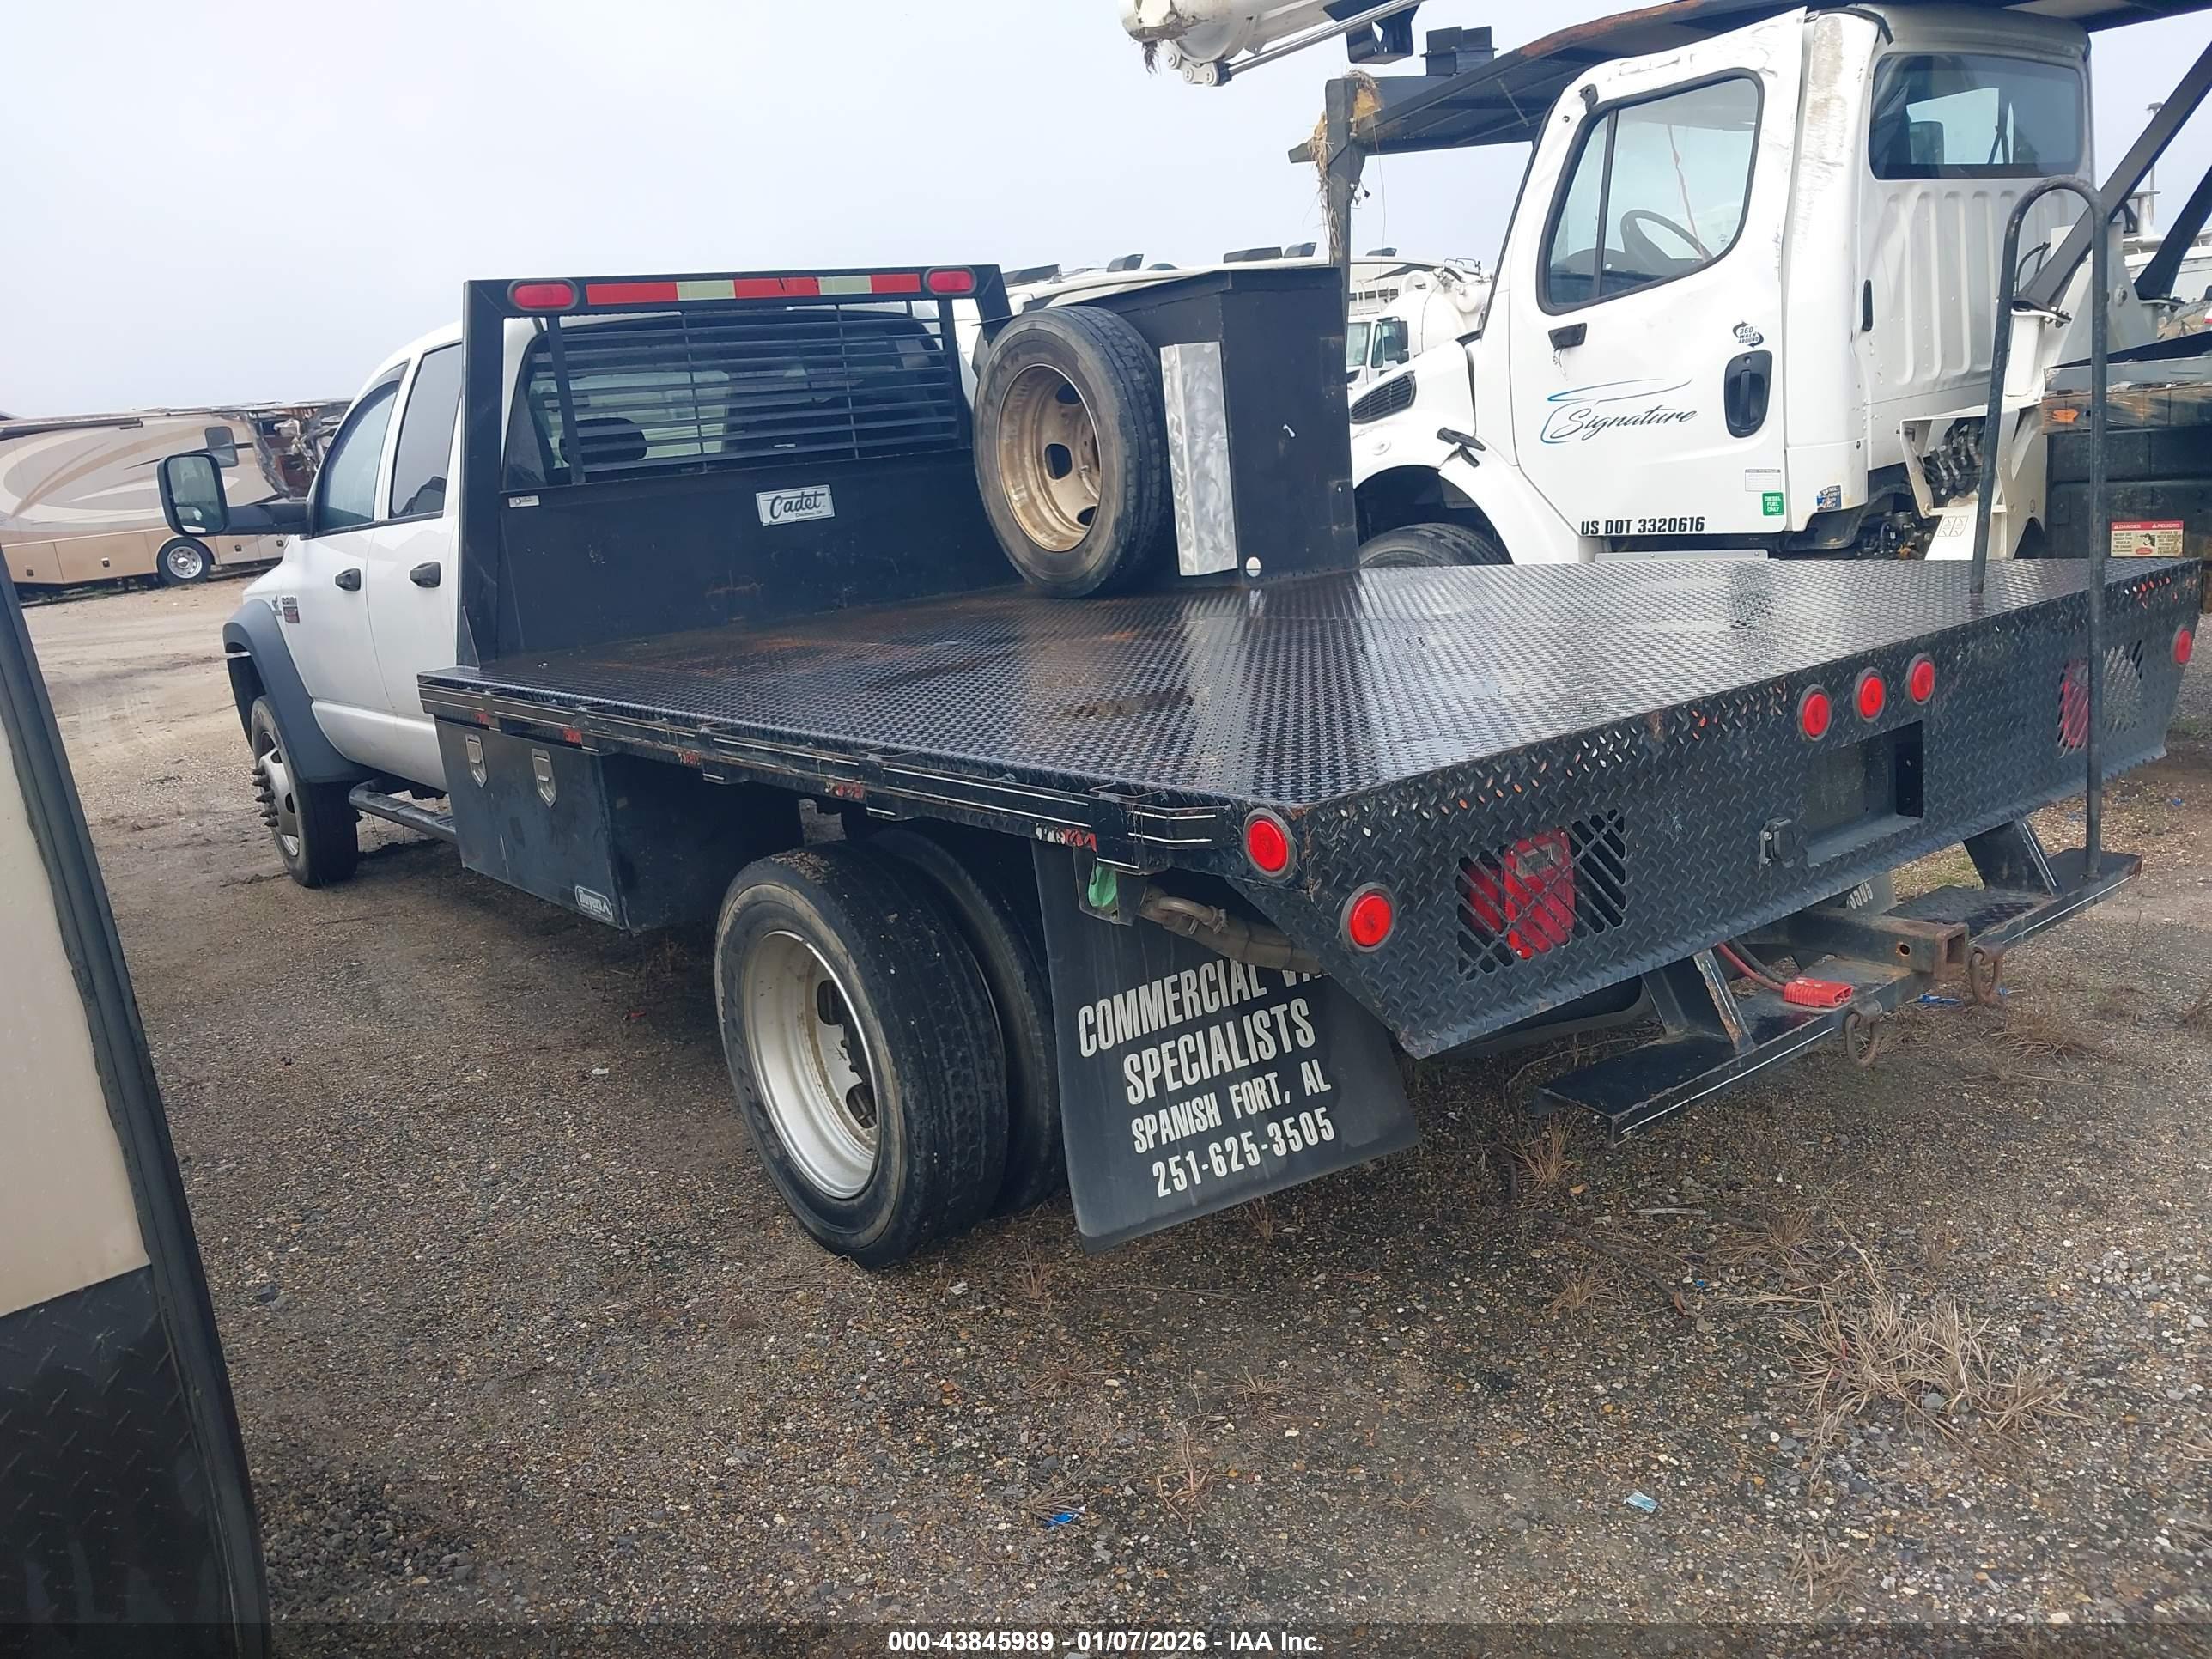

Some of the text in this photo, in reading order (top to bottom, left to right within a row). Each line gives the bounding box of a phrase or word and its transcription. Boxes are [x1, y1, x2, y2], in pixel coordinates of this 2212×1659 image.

[1549, 404, 1698, 441] Signature
[769, 491, 823, 519] Cadet
[1581, 516, 1705, 535] US DOT 3320616
[1078, 958, 1267, 1058] COMMERCIAL
[1123, 998, 1316, 1105] SPECIALISTS
[1131, 1059, 1331, 1154] SPANISH FORT, AL
[1152, 1106, 1335, 1198] 251-625-3505
